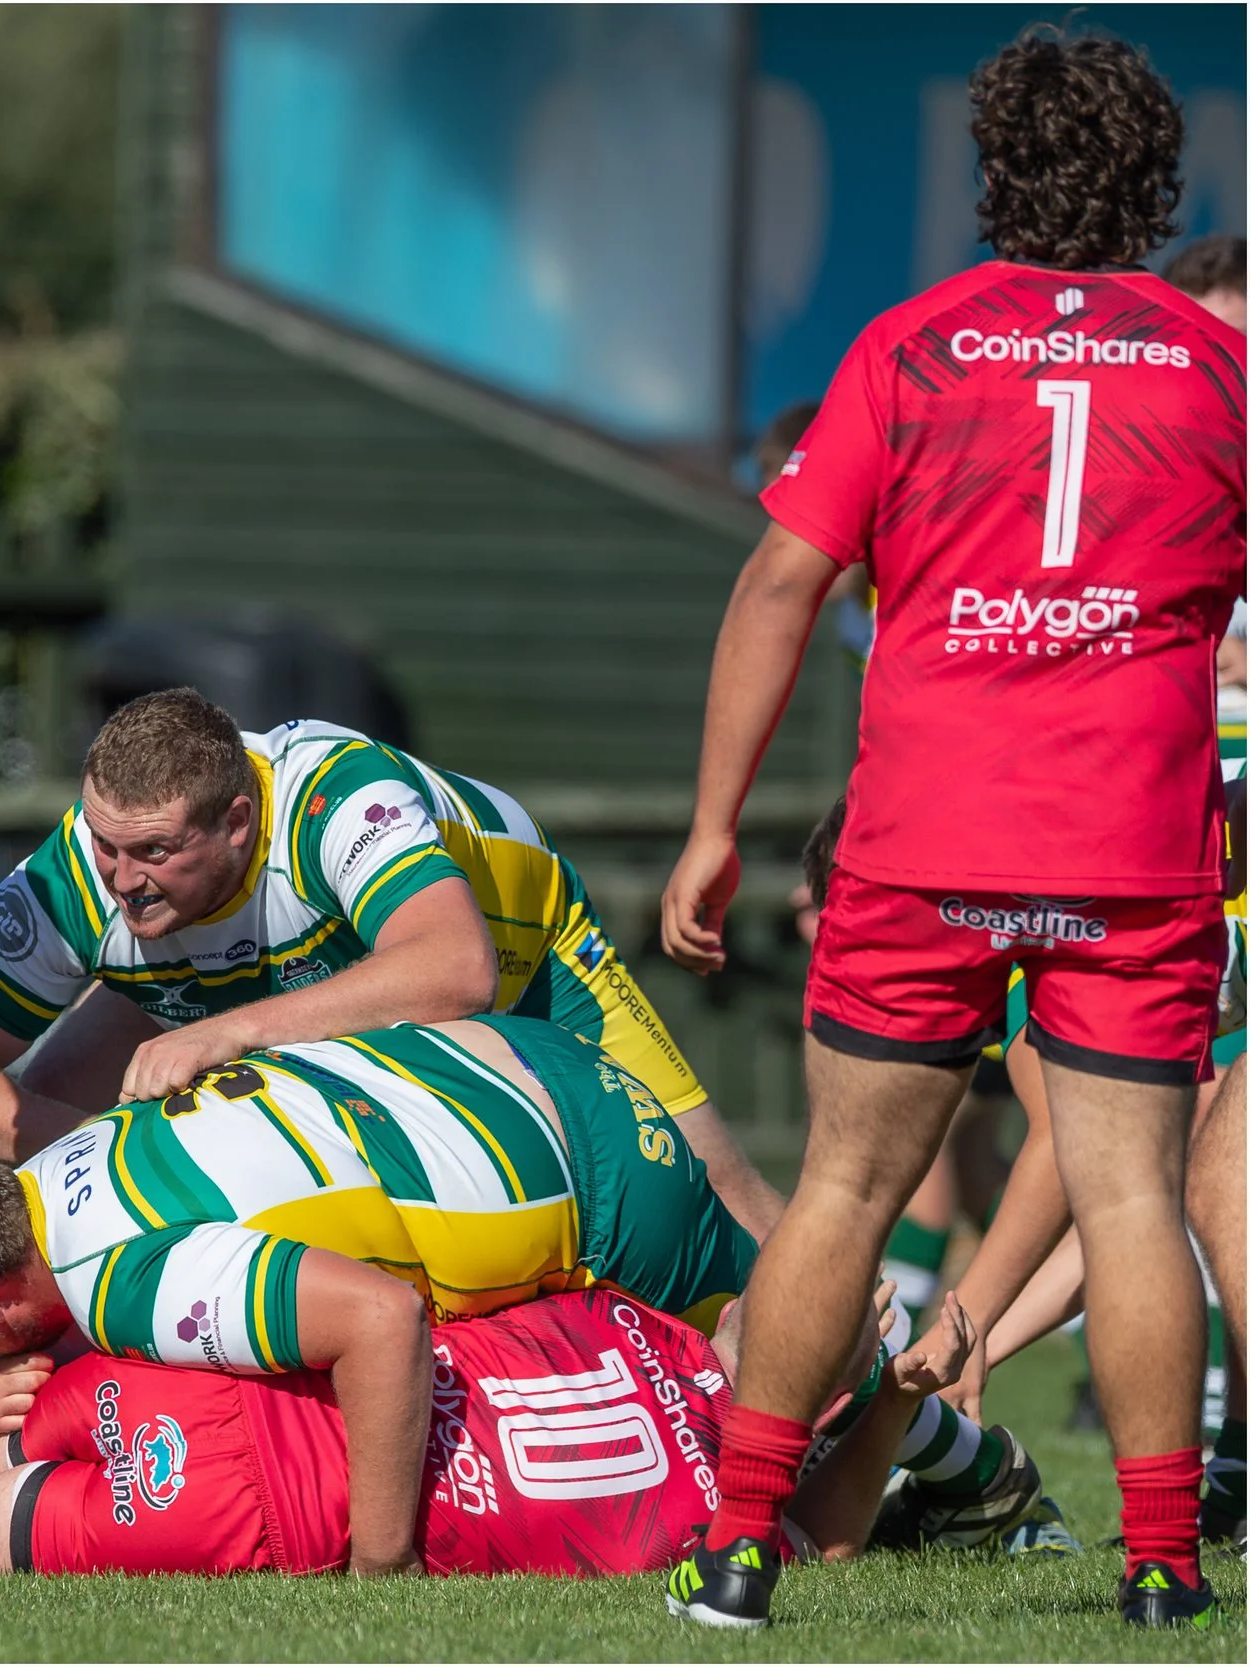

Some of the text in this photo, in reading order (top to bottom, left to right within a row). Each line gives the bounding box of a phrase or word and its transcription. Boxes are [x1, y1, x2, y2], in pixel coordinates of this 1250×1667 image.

[950, 328, 1191, 368] CoinShares
[1036, 379, 1091, 569] 1
[950, 587, 1141, 638] Polygon
[226, 942, 255, 960] 360
[939, 896, 1108, 943] Coastline
[96, 1379, 136, 1527] Coastline
[478, 1347, 670, 1501] 10
[613, 1303, 723, 1512] CoinShares
